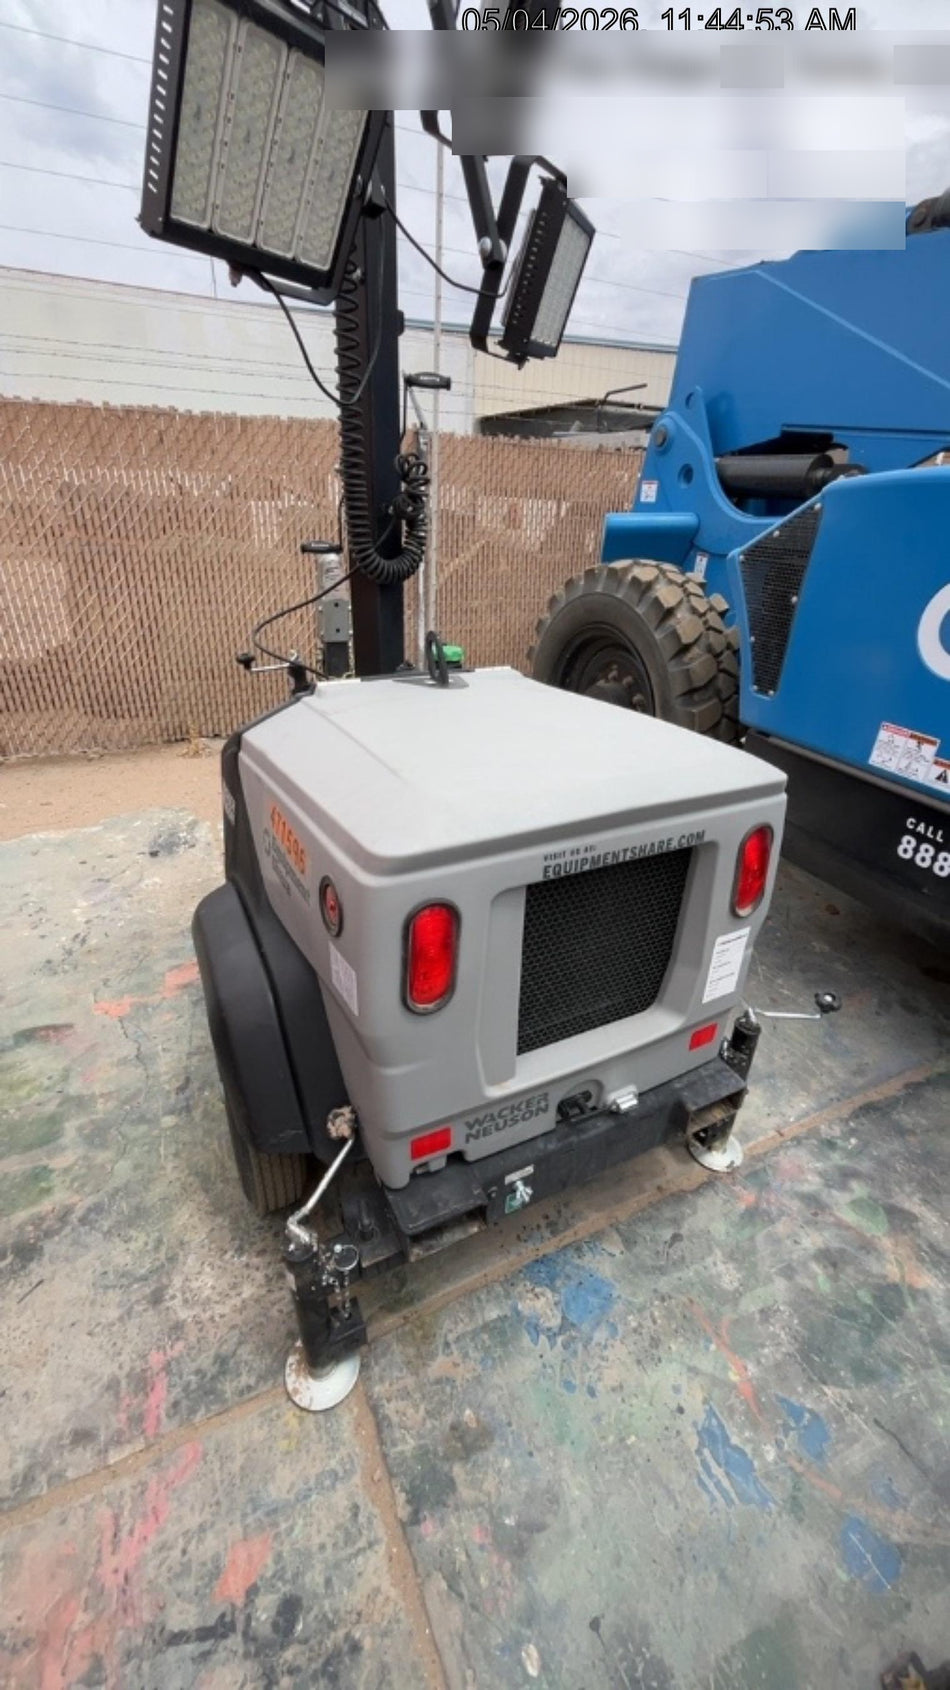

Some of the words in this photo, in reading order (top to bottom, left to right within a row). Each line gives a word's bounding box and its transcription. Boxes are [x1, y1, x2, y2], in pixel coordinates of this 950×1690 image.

[906, 817, 944, 843] CALL
[542, 829, 706, 879] EQUIPMENTSHARE.COM
[897, 834, 950, 878] 888
[465, 1092, 549, 1131] WACKER
[465, 1103, 549, 1144] NEUSON
